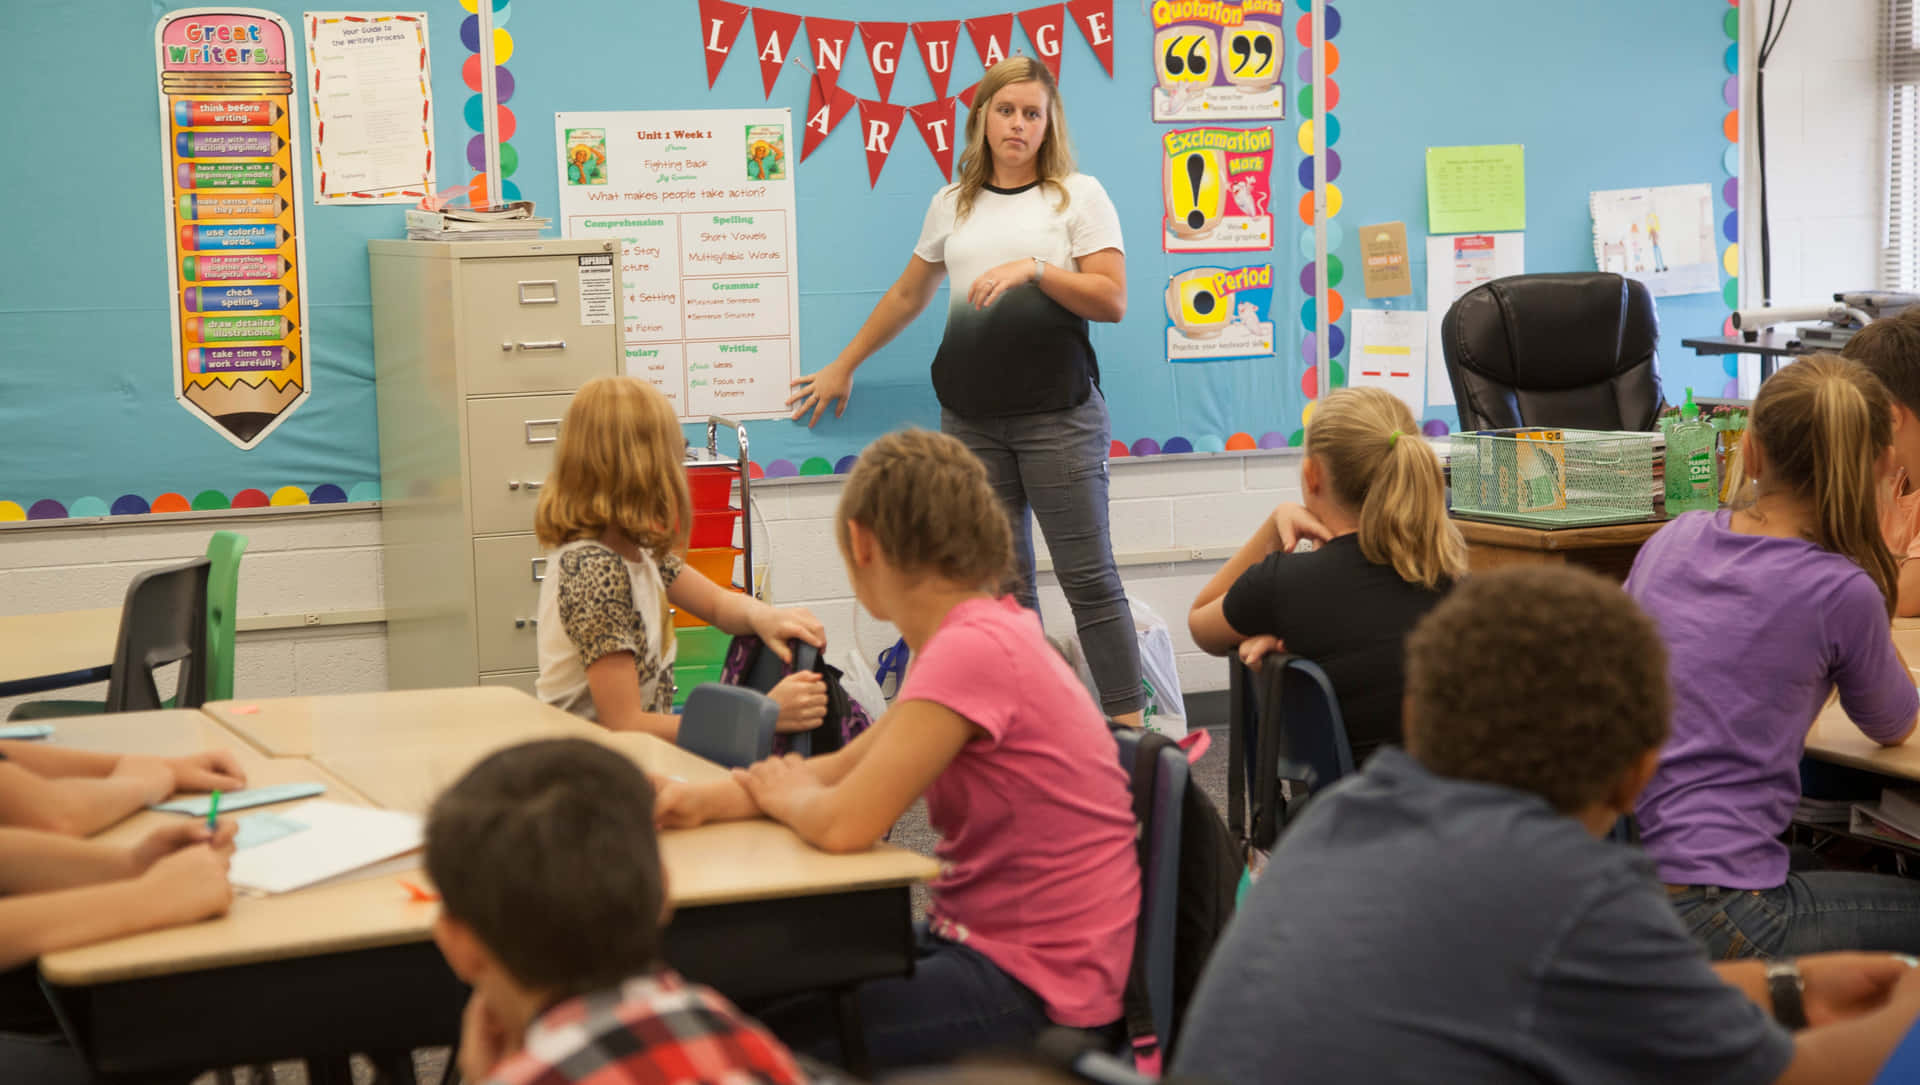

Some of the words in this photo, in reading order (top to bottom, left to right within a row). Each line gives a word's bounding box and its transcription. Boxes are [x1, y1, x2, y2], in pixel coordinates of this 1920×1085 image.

[1152, 0, 1243, 24] Quotation
[185, 23, 261, 42] Great
[706, 12, 1111, 74] LANGUAGE
[200, 104, 225, 112] think
[227, 104, 260, 112] before
[214, 114, 251, 124] writing.
[637, 130, 662, 140] Unit
[665, 131, 671, 139] 1
[673, 130, 704, 139] Week
[707, 131, 712, 139] 1
[1165, 128, 1271, 155] Exclamation
[644, 160, 682, 173] Fighting
[685, 160, 708, 168] Back
[1229, 157, 1264, 174] Mark
[587, 191, 619, 201] What
[624, 191, 658, 200] makes
[662, 190, 696, 203] people
[701, 188, 724, 199] take
[728, 187, 767, 198] action?
[584, 218, 664, 229] Comprehension
[712, 215, 754, 226] Spelling
[228, 227, 266, 236] colorful
[222, 238, 255, 246] words.
[700, 232, 727, 242] Short
[731, 232, 767, 241] Vowels
[633, 246, 660, 258] Story
[688, 251, 745, 265] Multisyllabic
[748, 250, 781, 260] Words
[622, 263, 649, 272] cture
[1213, 264, 1271, 296] Period
[712, 282, 760, 290] Grammar
[226, 288, 253, 297] check
[221, 298, 263, 308] spelling.
[639, 292, 676, 304] Setting
[207, 320, 233, 328] draw
[235, 318, 276, 327] detailed
[635, 323, 663, 332] Fiction
[625, 348, 659, 358] bulary
[719, 344, 758, 353] Writing
[212, 350, 233, 359] take
[237, 350, 258, 358] time
[261, 349, 272, 357] to
[208, 359, 231, 368] work
[234, 359, 281, 369] carefully.
[712, 377, 735, 385] Focus
[714, 389, 745, 398] Moment
